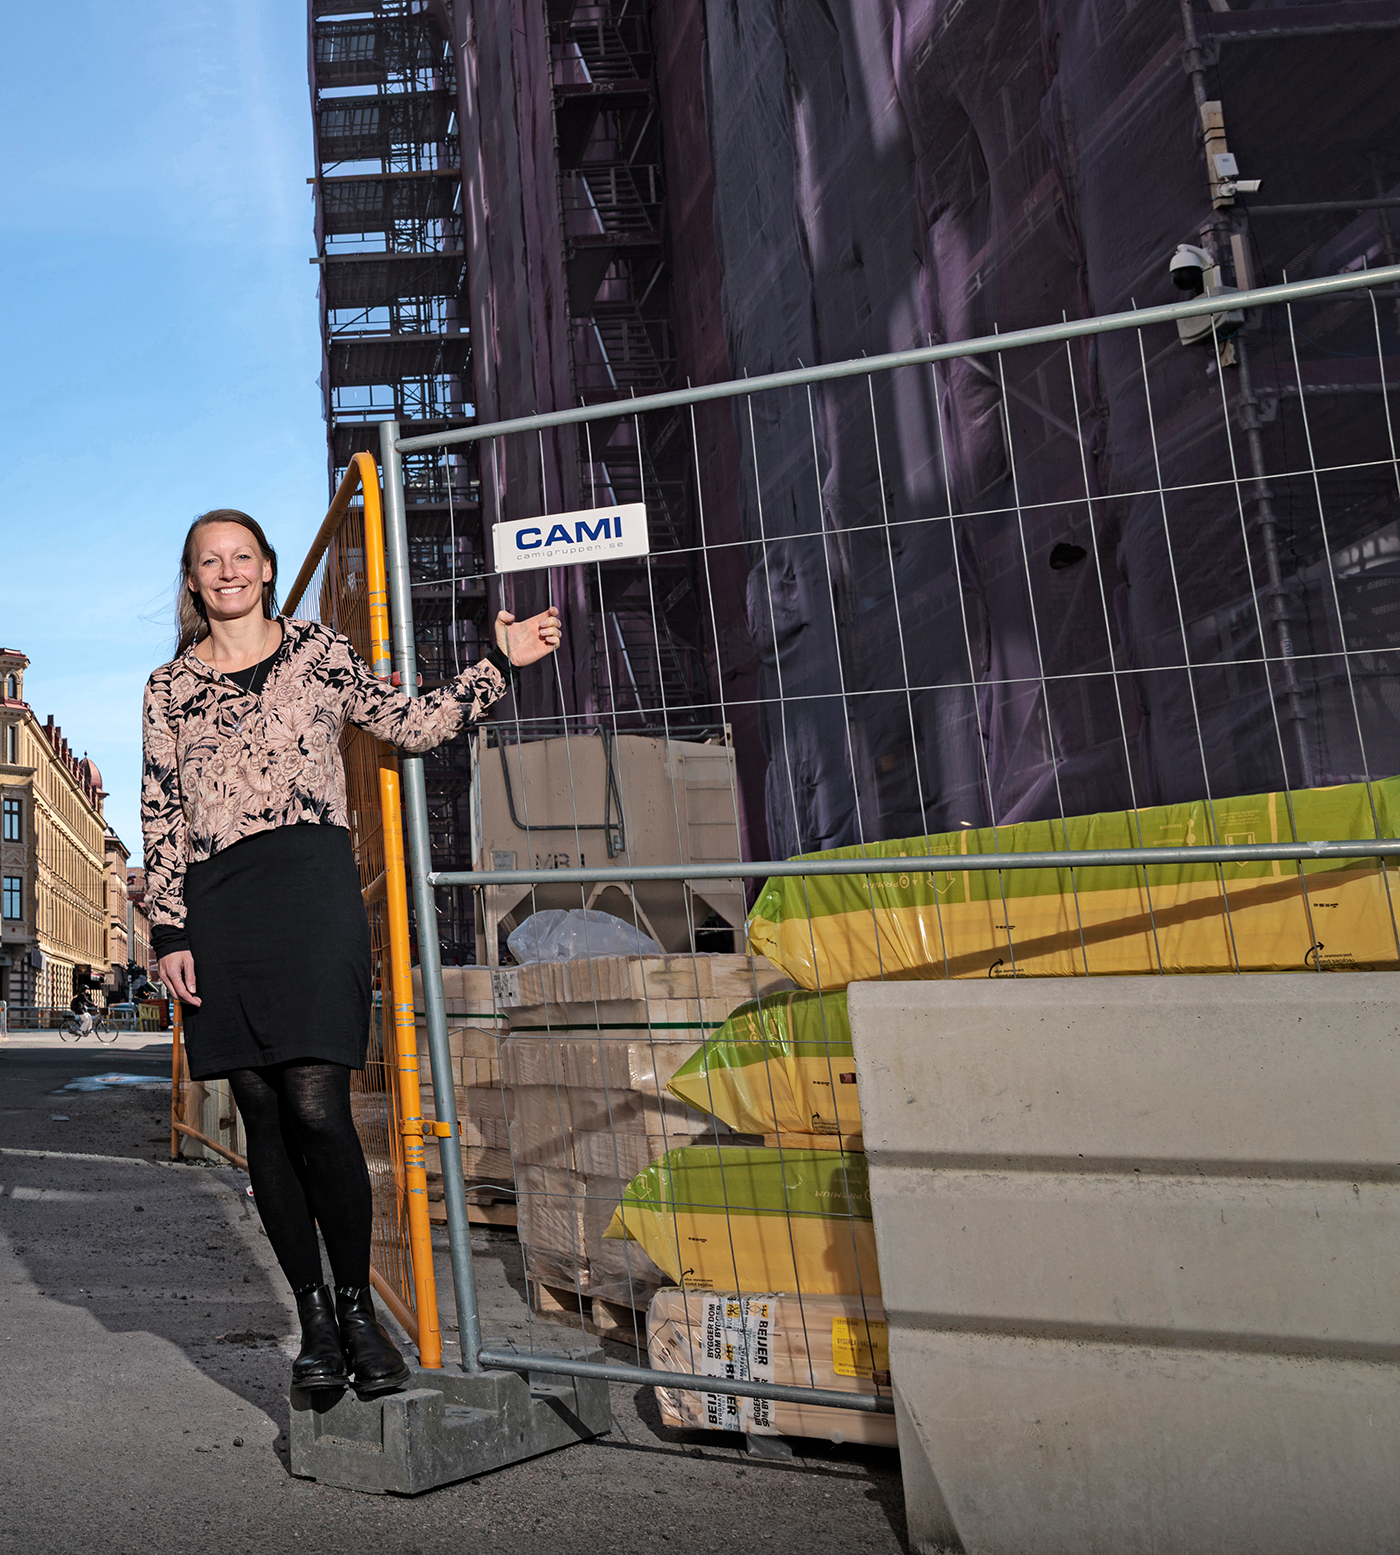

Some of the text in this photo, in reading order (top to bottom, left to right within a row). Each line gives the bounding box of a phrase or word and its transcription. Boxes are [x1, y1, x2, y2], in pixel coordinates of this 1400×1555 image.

[515, 516, 622, 550] CAMI
[516, 541, 624, 561] camigruppen.se
[814, 1190, 863, 1200] PREMIUM
[708, 1303, 716, 1323] DOM
[714, 1339, 722, 1360] SOM
[757, 1320, 768, 1365] BEIJER
[761, 1411, 770, 1428] SOM
